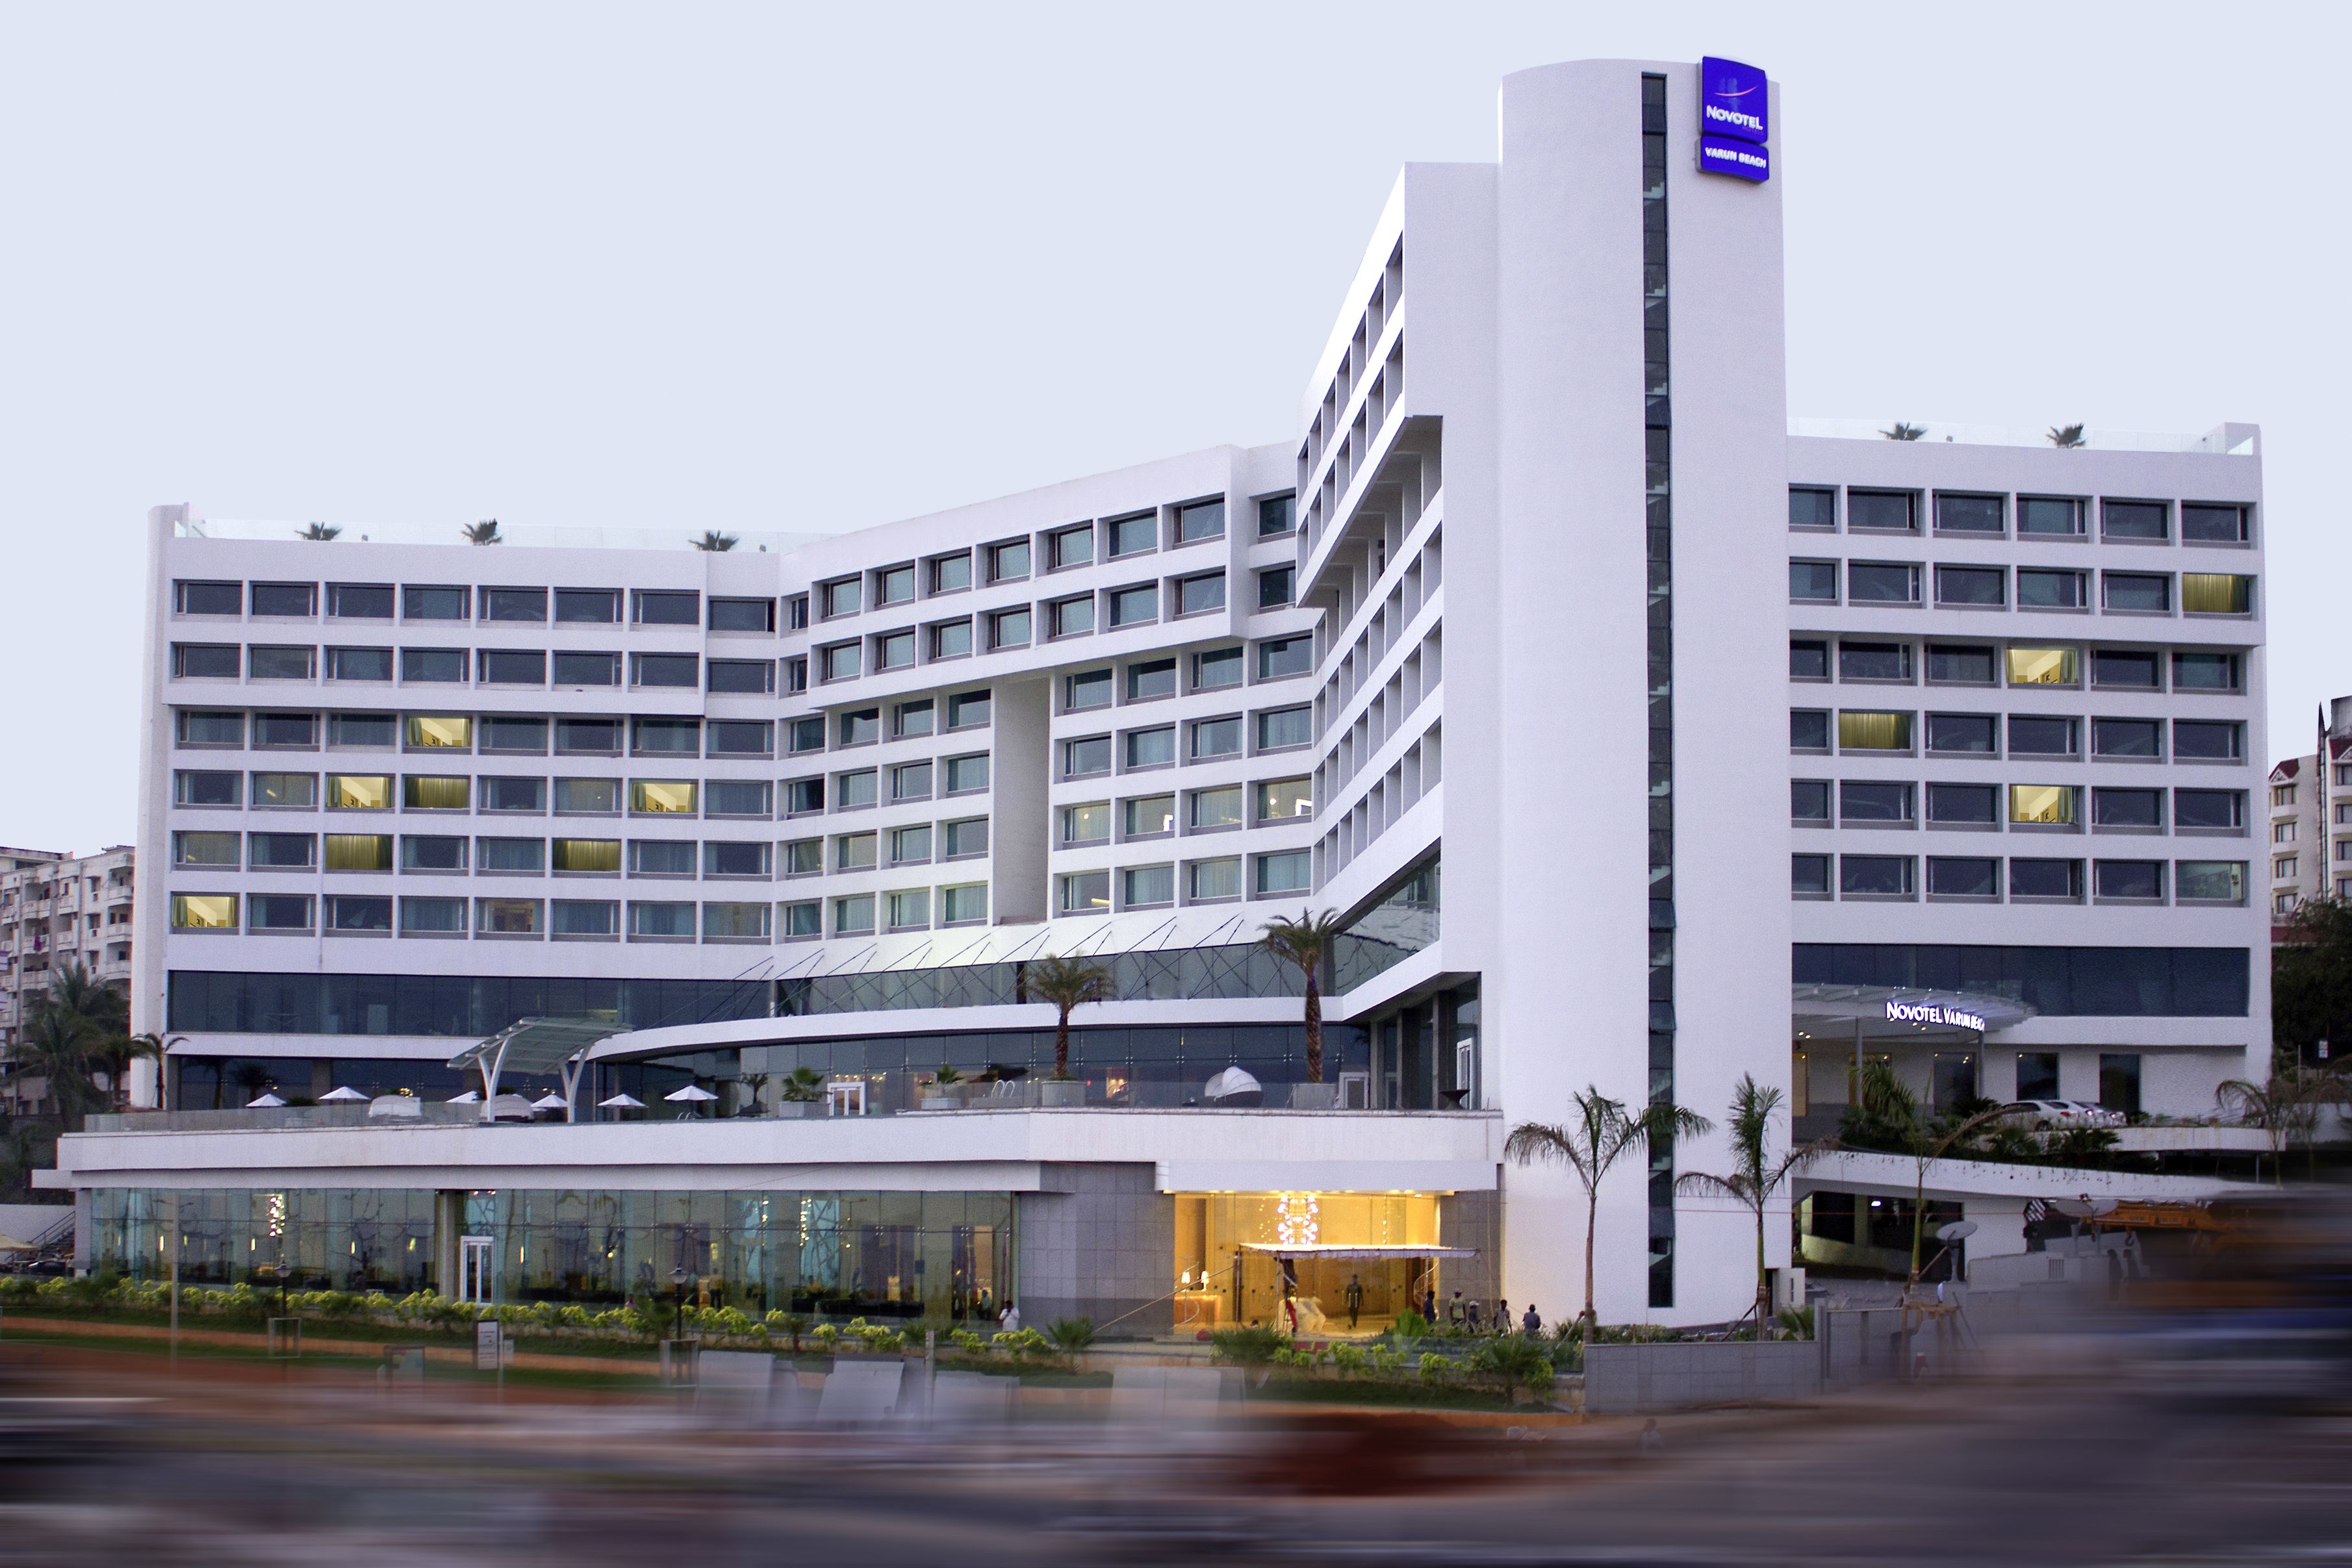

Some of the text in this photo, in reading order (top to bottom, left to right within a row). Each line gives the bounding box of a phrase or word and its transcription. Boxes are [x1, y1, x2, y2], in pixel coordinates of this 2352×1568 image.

[1706, 105, 1763, 131] NOVOTEL
[1705, 147, 1767, 169] VARUN BEACH
[1886, 1002, 1943, 1023] NOVOTEL
[1943, 1008, 1971, 1028] VARUN
